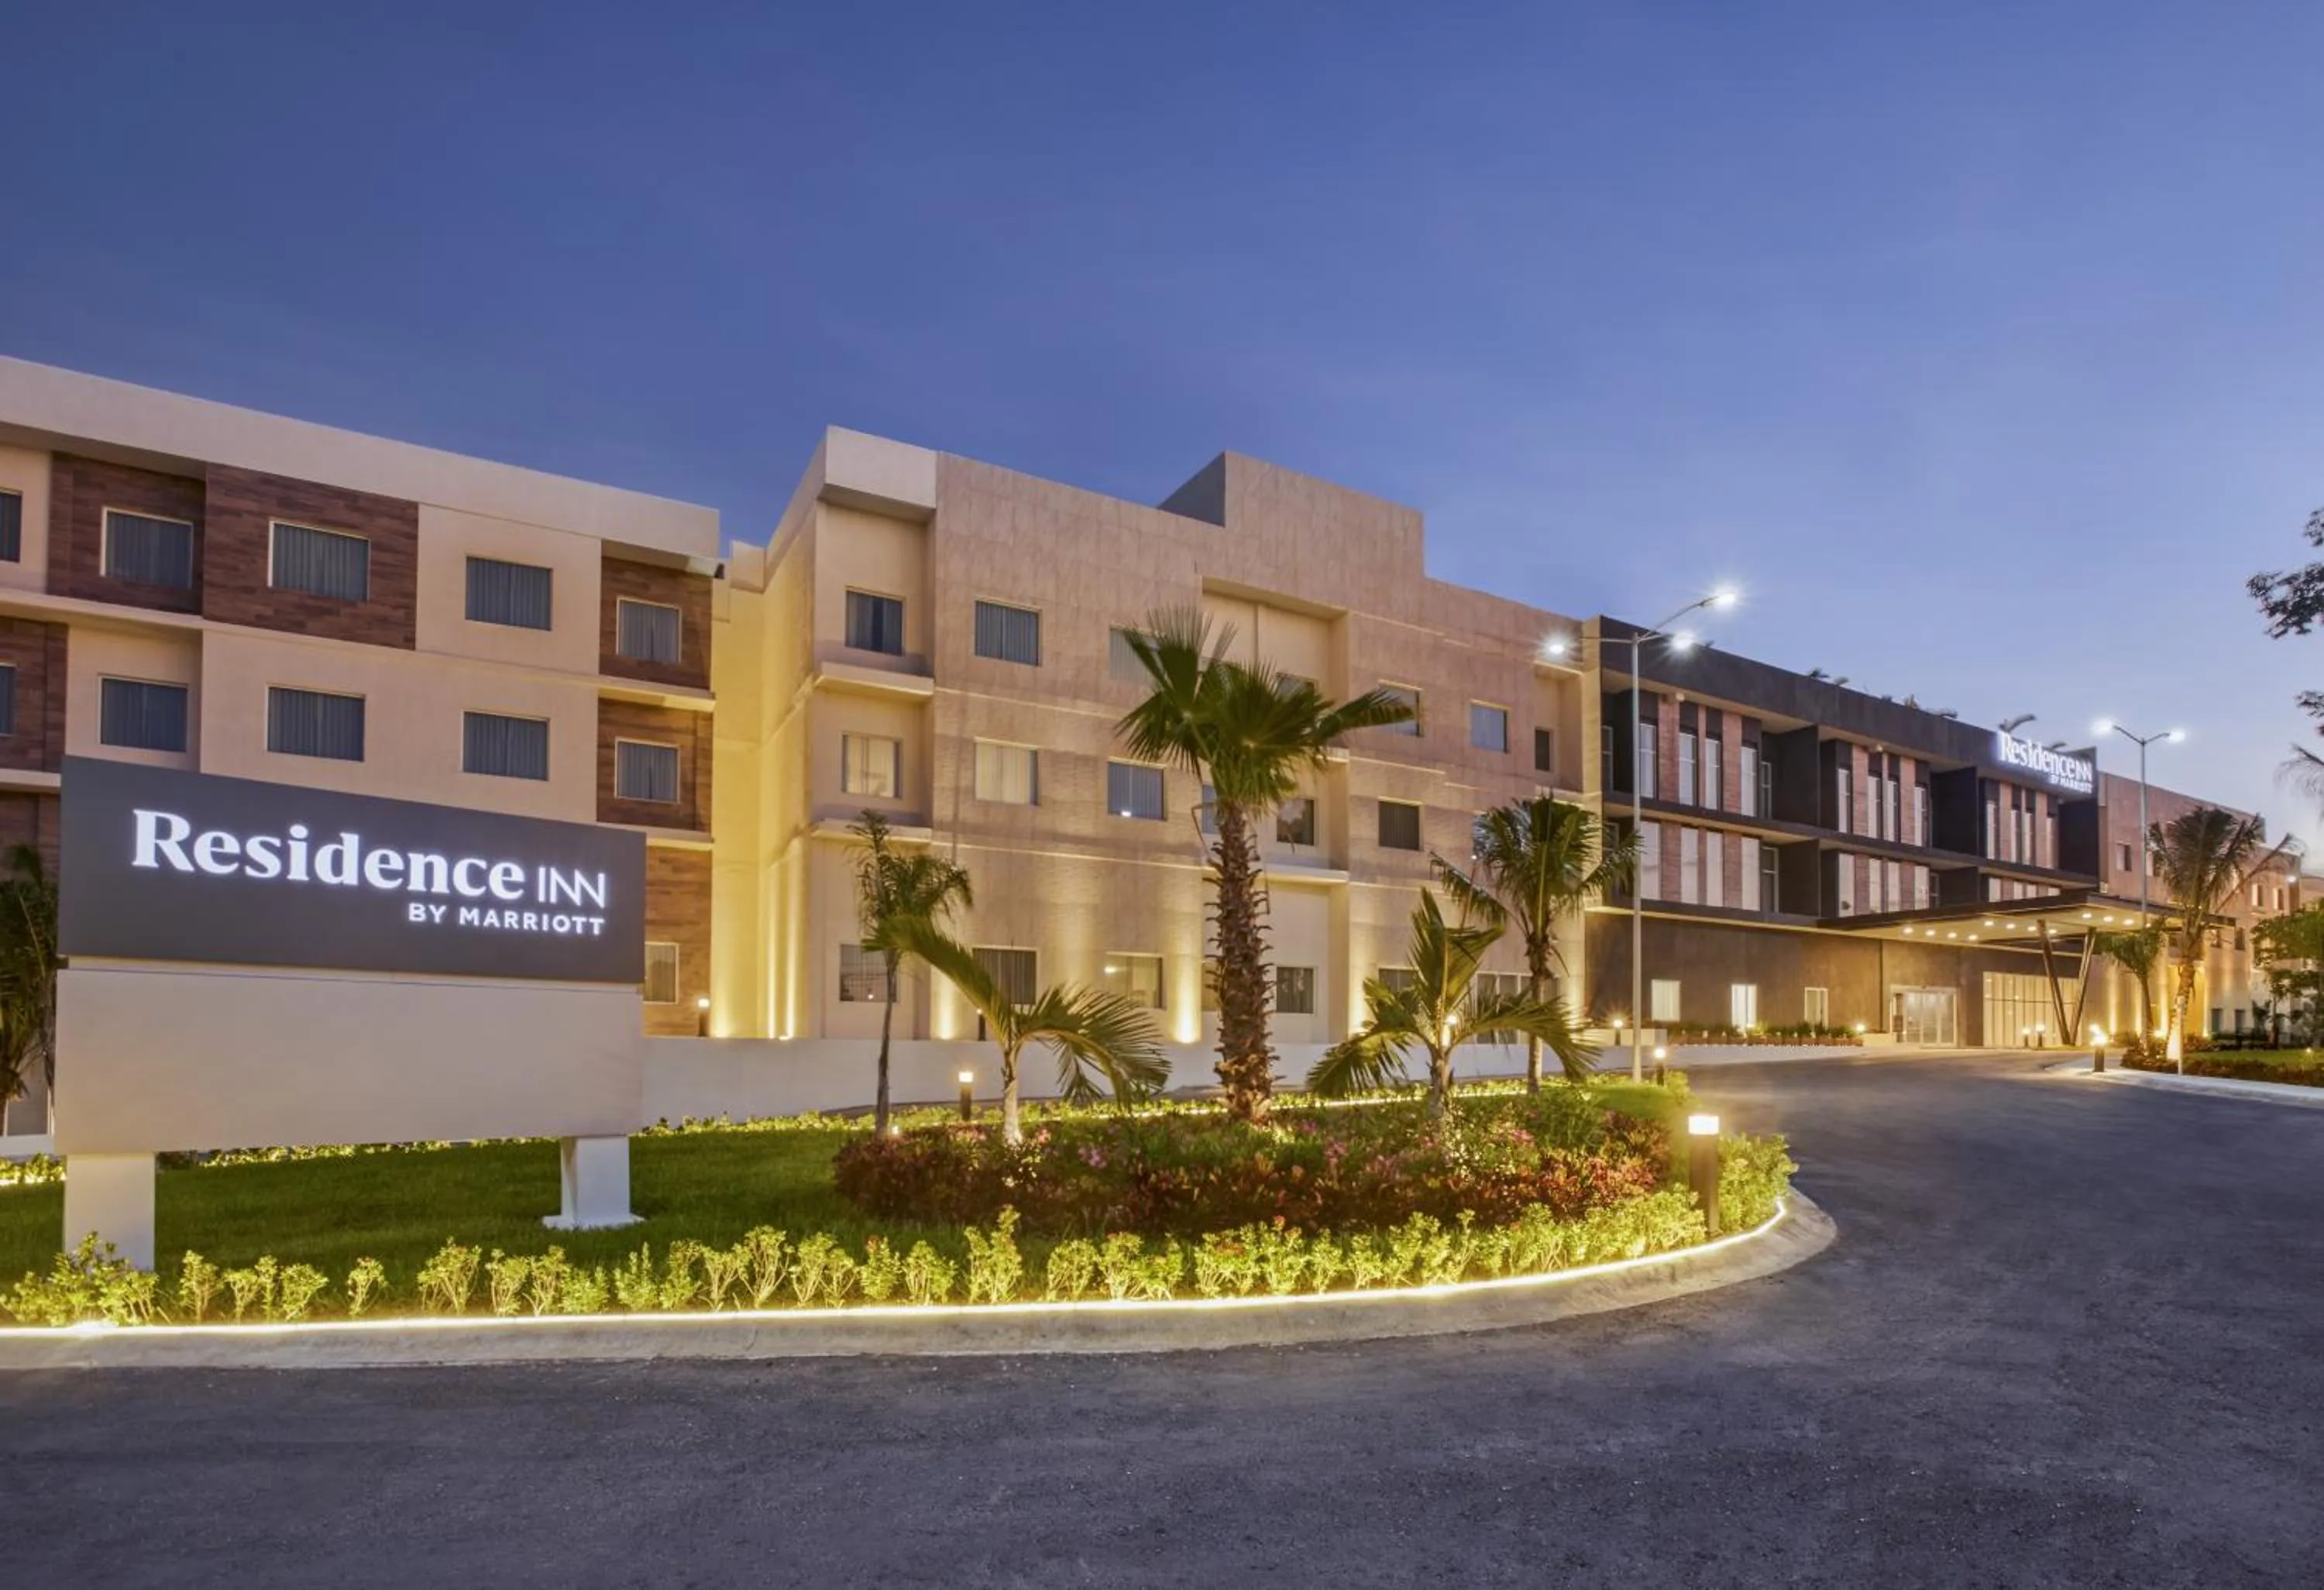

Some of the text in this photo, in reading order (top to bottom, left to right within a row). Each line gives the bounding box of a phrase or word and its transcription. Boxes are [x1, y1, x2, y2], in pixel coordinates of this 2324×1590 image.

[1997, 731, 2075, 778] Residence
[132, 810, 606, 908] Residence INN
[408, 903, 605, 935] BY MARRIOTT
